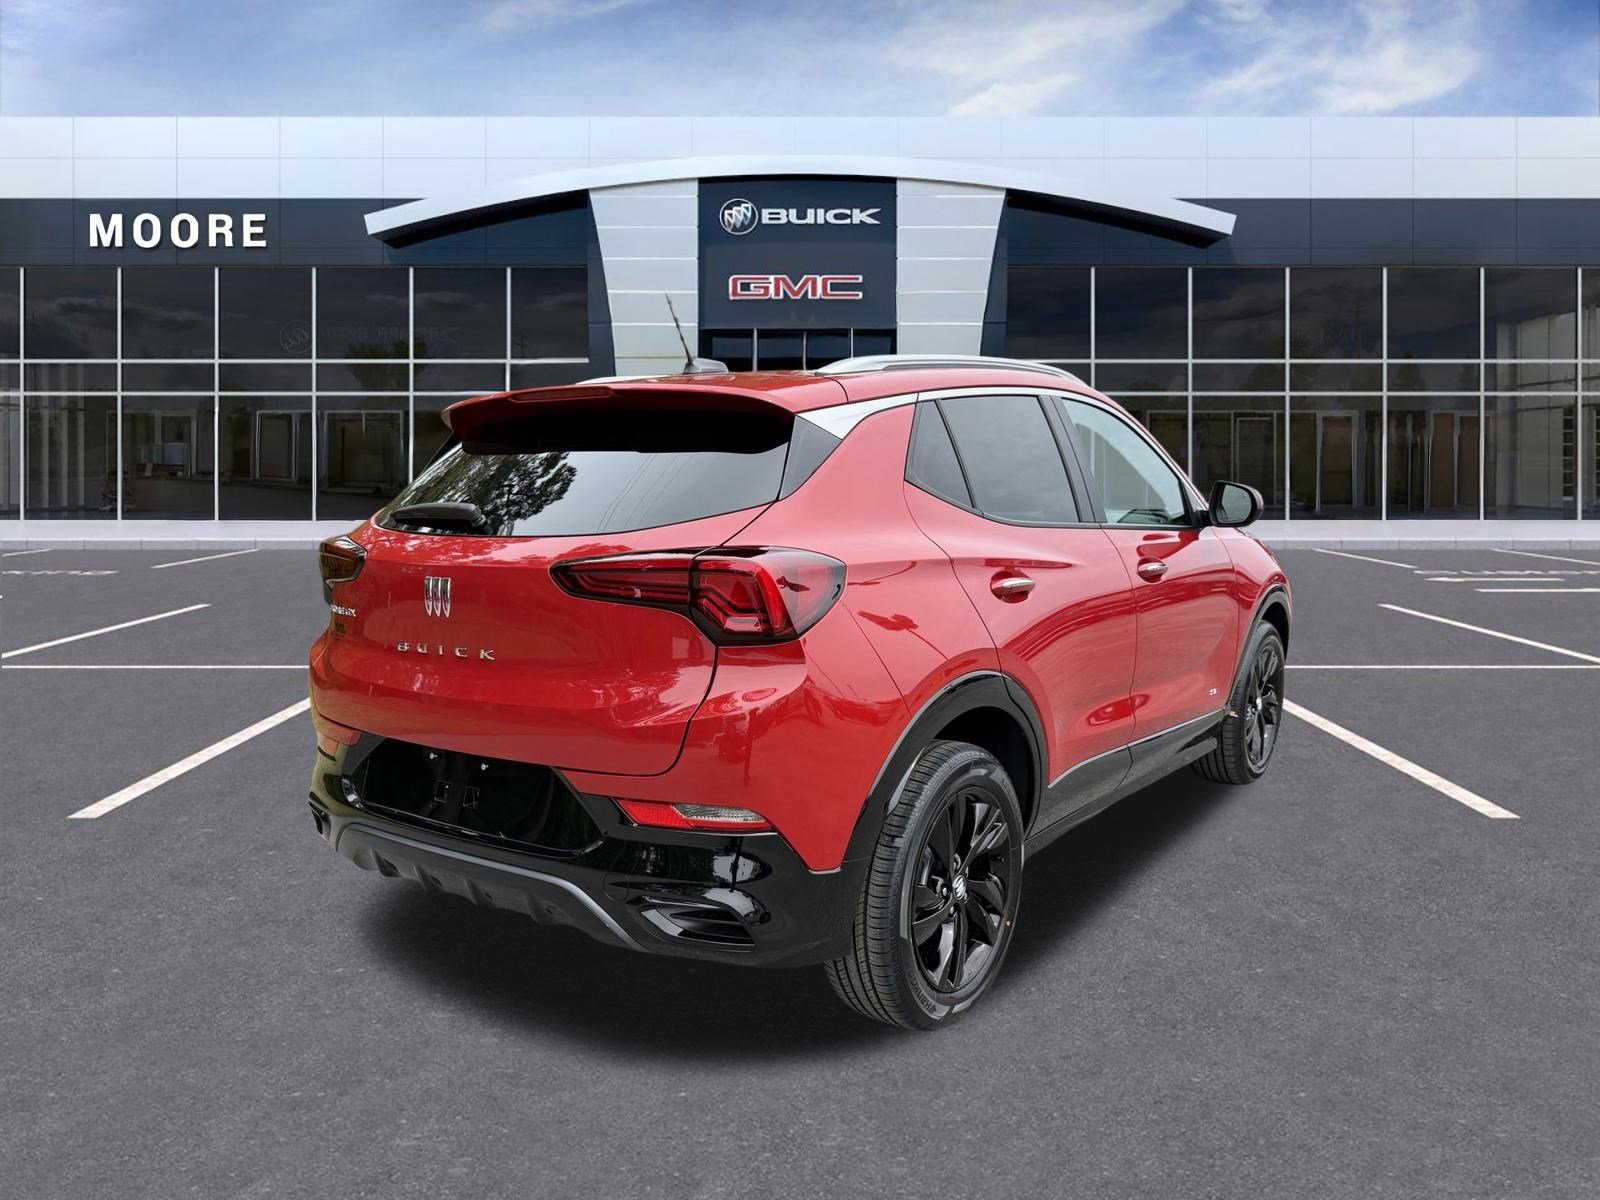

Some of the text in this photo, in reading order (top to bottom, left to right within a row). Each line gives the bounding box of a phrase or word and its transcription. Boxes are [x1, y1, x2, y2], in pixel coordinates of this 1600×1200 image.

[761, 208, 881, 224] BUICK
[89, 212, 267, 248] MOORE
[729, 274, 863, 300] GMC
[397, 642, 496, 661] BUICK
